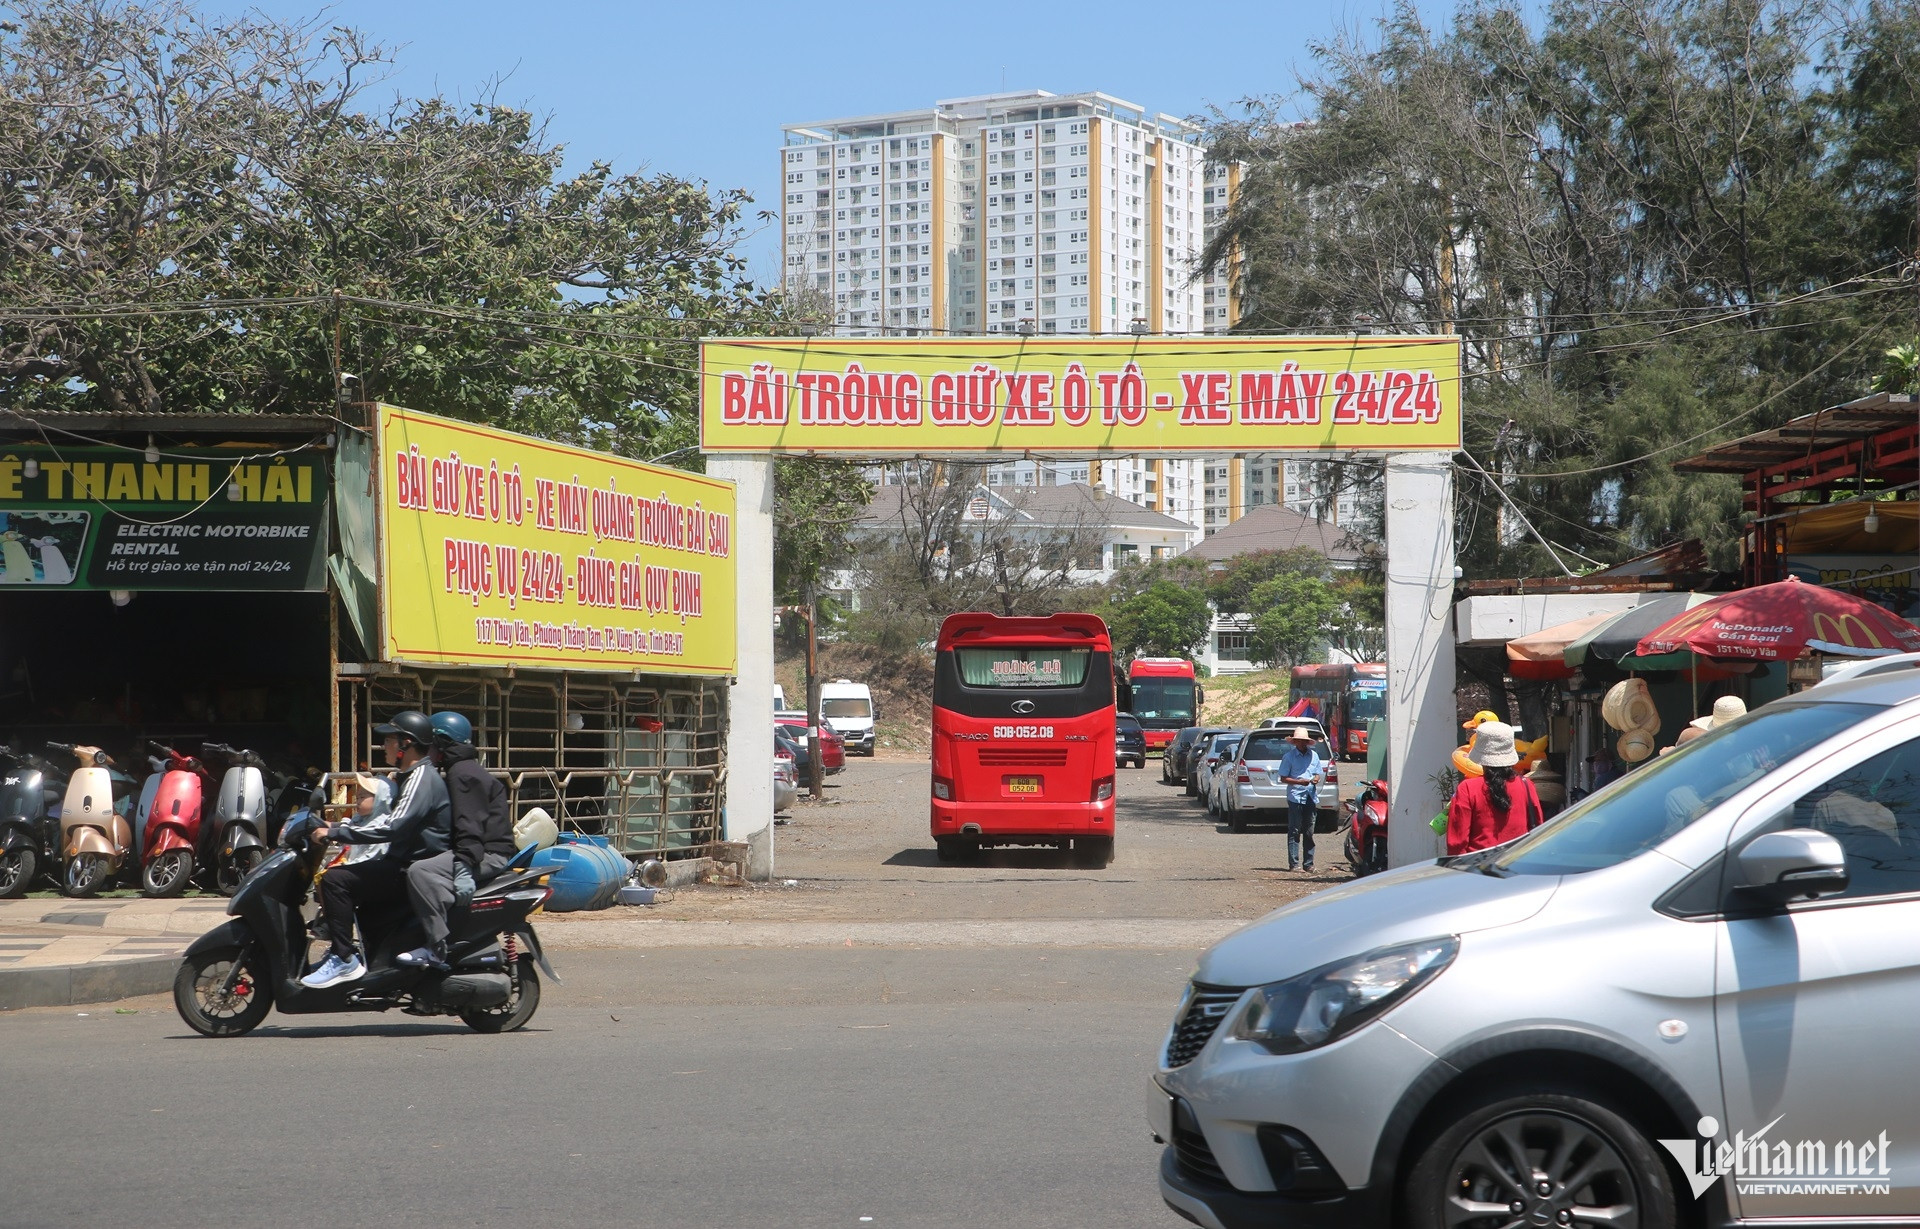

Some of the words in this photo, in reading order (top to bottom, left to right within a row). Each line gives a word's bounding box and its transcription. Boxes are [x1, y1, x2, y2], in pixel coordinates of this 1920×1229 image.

[723, 361, 789, 426] BÃI
[796, 360, 922, 426] TRÔNG
[928, 362, 1001, 426] GIỮ
[1003, 370, 1054, 426] XE
[1060, 360, 1091, 426] Ô
[1096, 360, 1148, 426] TÔ
[1153, 392, 1173, 411] -
[1178, 368, 1232, 425] XE
[1240, 360, 1327, 425] MÁY
[1332, 367, 1441, 425] 24/24
[41, 462, 209, 501] THANH
[229, 457, 312, 502] HẢI
[397, 445, 428, 511] BÃI
[432, 452, 463, 515] GIỮ
[464, 464, 486, 520] XE
[488, 458, 501, 522] Ô
[503, 463, 523, 526] TÔ
[526, 498, 533, 512] -
[535, 478, 556, 531] XE
[558, 475, 589, 536] MÁY
[592, 476, 635, 544] QUẢNG
[637, 491, 684, 551] TRƯỜNG
[686, 500, 706, 555] BÃI
[708, 510, 730, 559] SAU
[117, 524, 201, 538] ELECTRIC
[204, 524, 310, 538] MOTORBIKE
[111, 542, 180, 556] RENTAL
[106, 558, 125, 571] Hỗ
[128, 560, 149, 574] trợ
[151, 560, 181, 573] giao
[183, 562, 200, 571] xe
[203, 560, 225, 575] tận
[228, 561, 251, 572] nơi
[252, 560, 291, 572] 24/24
[445, 537, 492, 606] PHỤC
[496, 546, 518, 611] VỤ
[521, 549, 564, 604] 24/24
[567, 574, 574, 590] -
[577, 548, 616, 609] ĐÚNG
[619, 554, 643, 612] GIÁ
[645, 563, 672, 617] QUY
[673, 568, 702, 625] ĐỊNH
[1819, 569, 1851, 588] XE
[1854, 564, 1912, 594] ĐIỆN
[1712, 621, 1794, 634] McDonald's
[475, 618, 492, 644] 117
[513, 619, 533, 649] Vân,
[533, 621, 562, 651] Phường
[563, 620, 586, 652] Thắng
[586, 625, 604, 653] Tam,
[604, 626, 616, 651] TP.
[616, 626, 633, 655] Vũng
[633, 628, 649, 656] Tàu,
[1749, 633, 1781, 643] bạn!
[1716, 645, 1732, 653] 151
[1759, 647, 1777, 657] Vân
[955, 732, 989, 740] THACO
